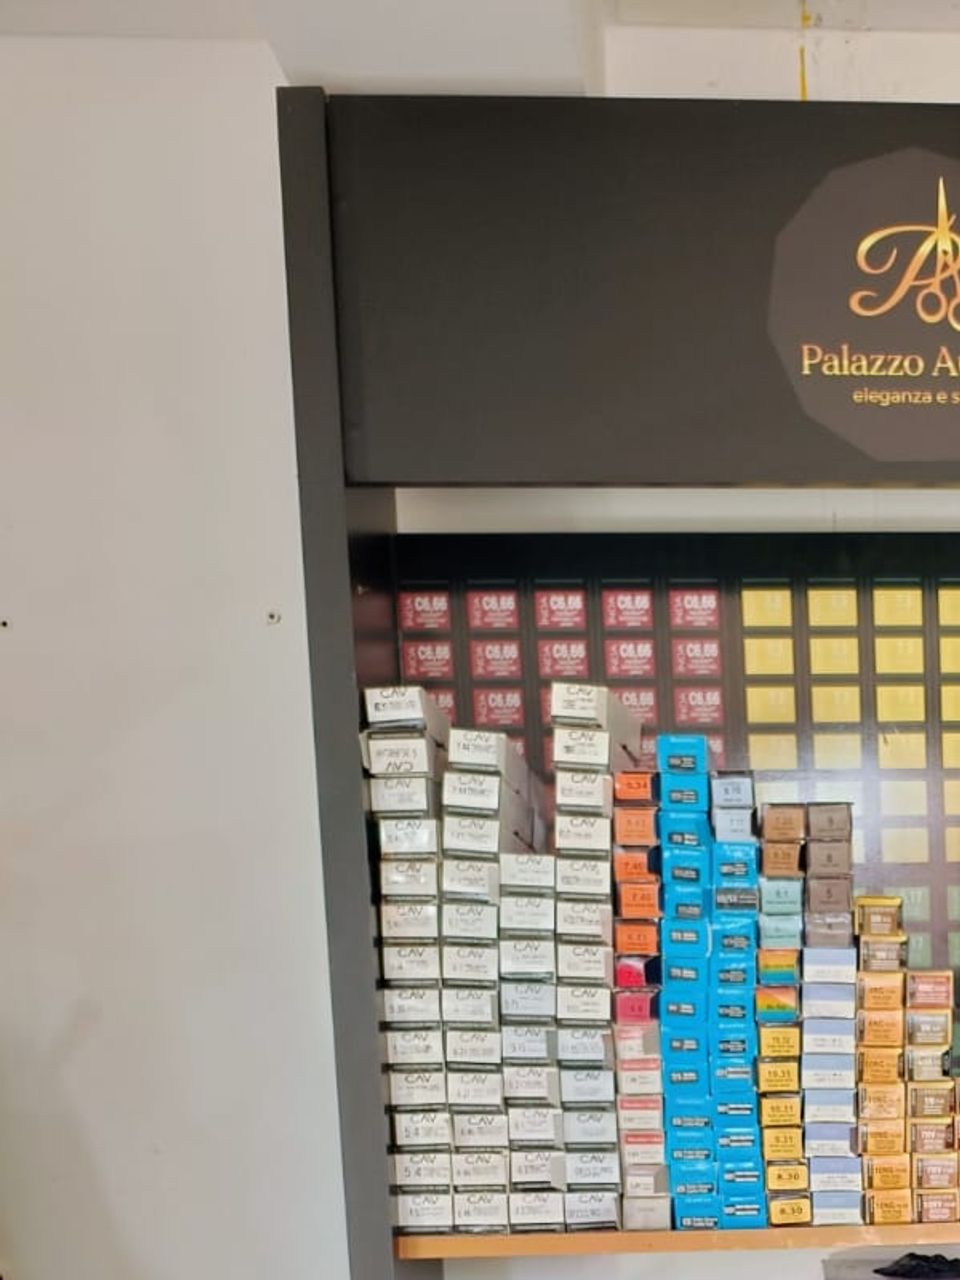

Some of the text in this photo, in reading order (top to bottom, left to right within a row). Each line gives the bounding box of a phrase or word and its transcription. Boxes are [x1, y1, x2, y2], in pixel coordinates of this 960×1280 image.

[801, 344, 924, 376] Palazzo
[852, 387, 932, 406] eleganza
[936, 390, 947, 404] e
